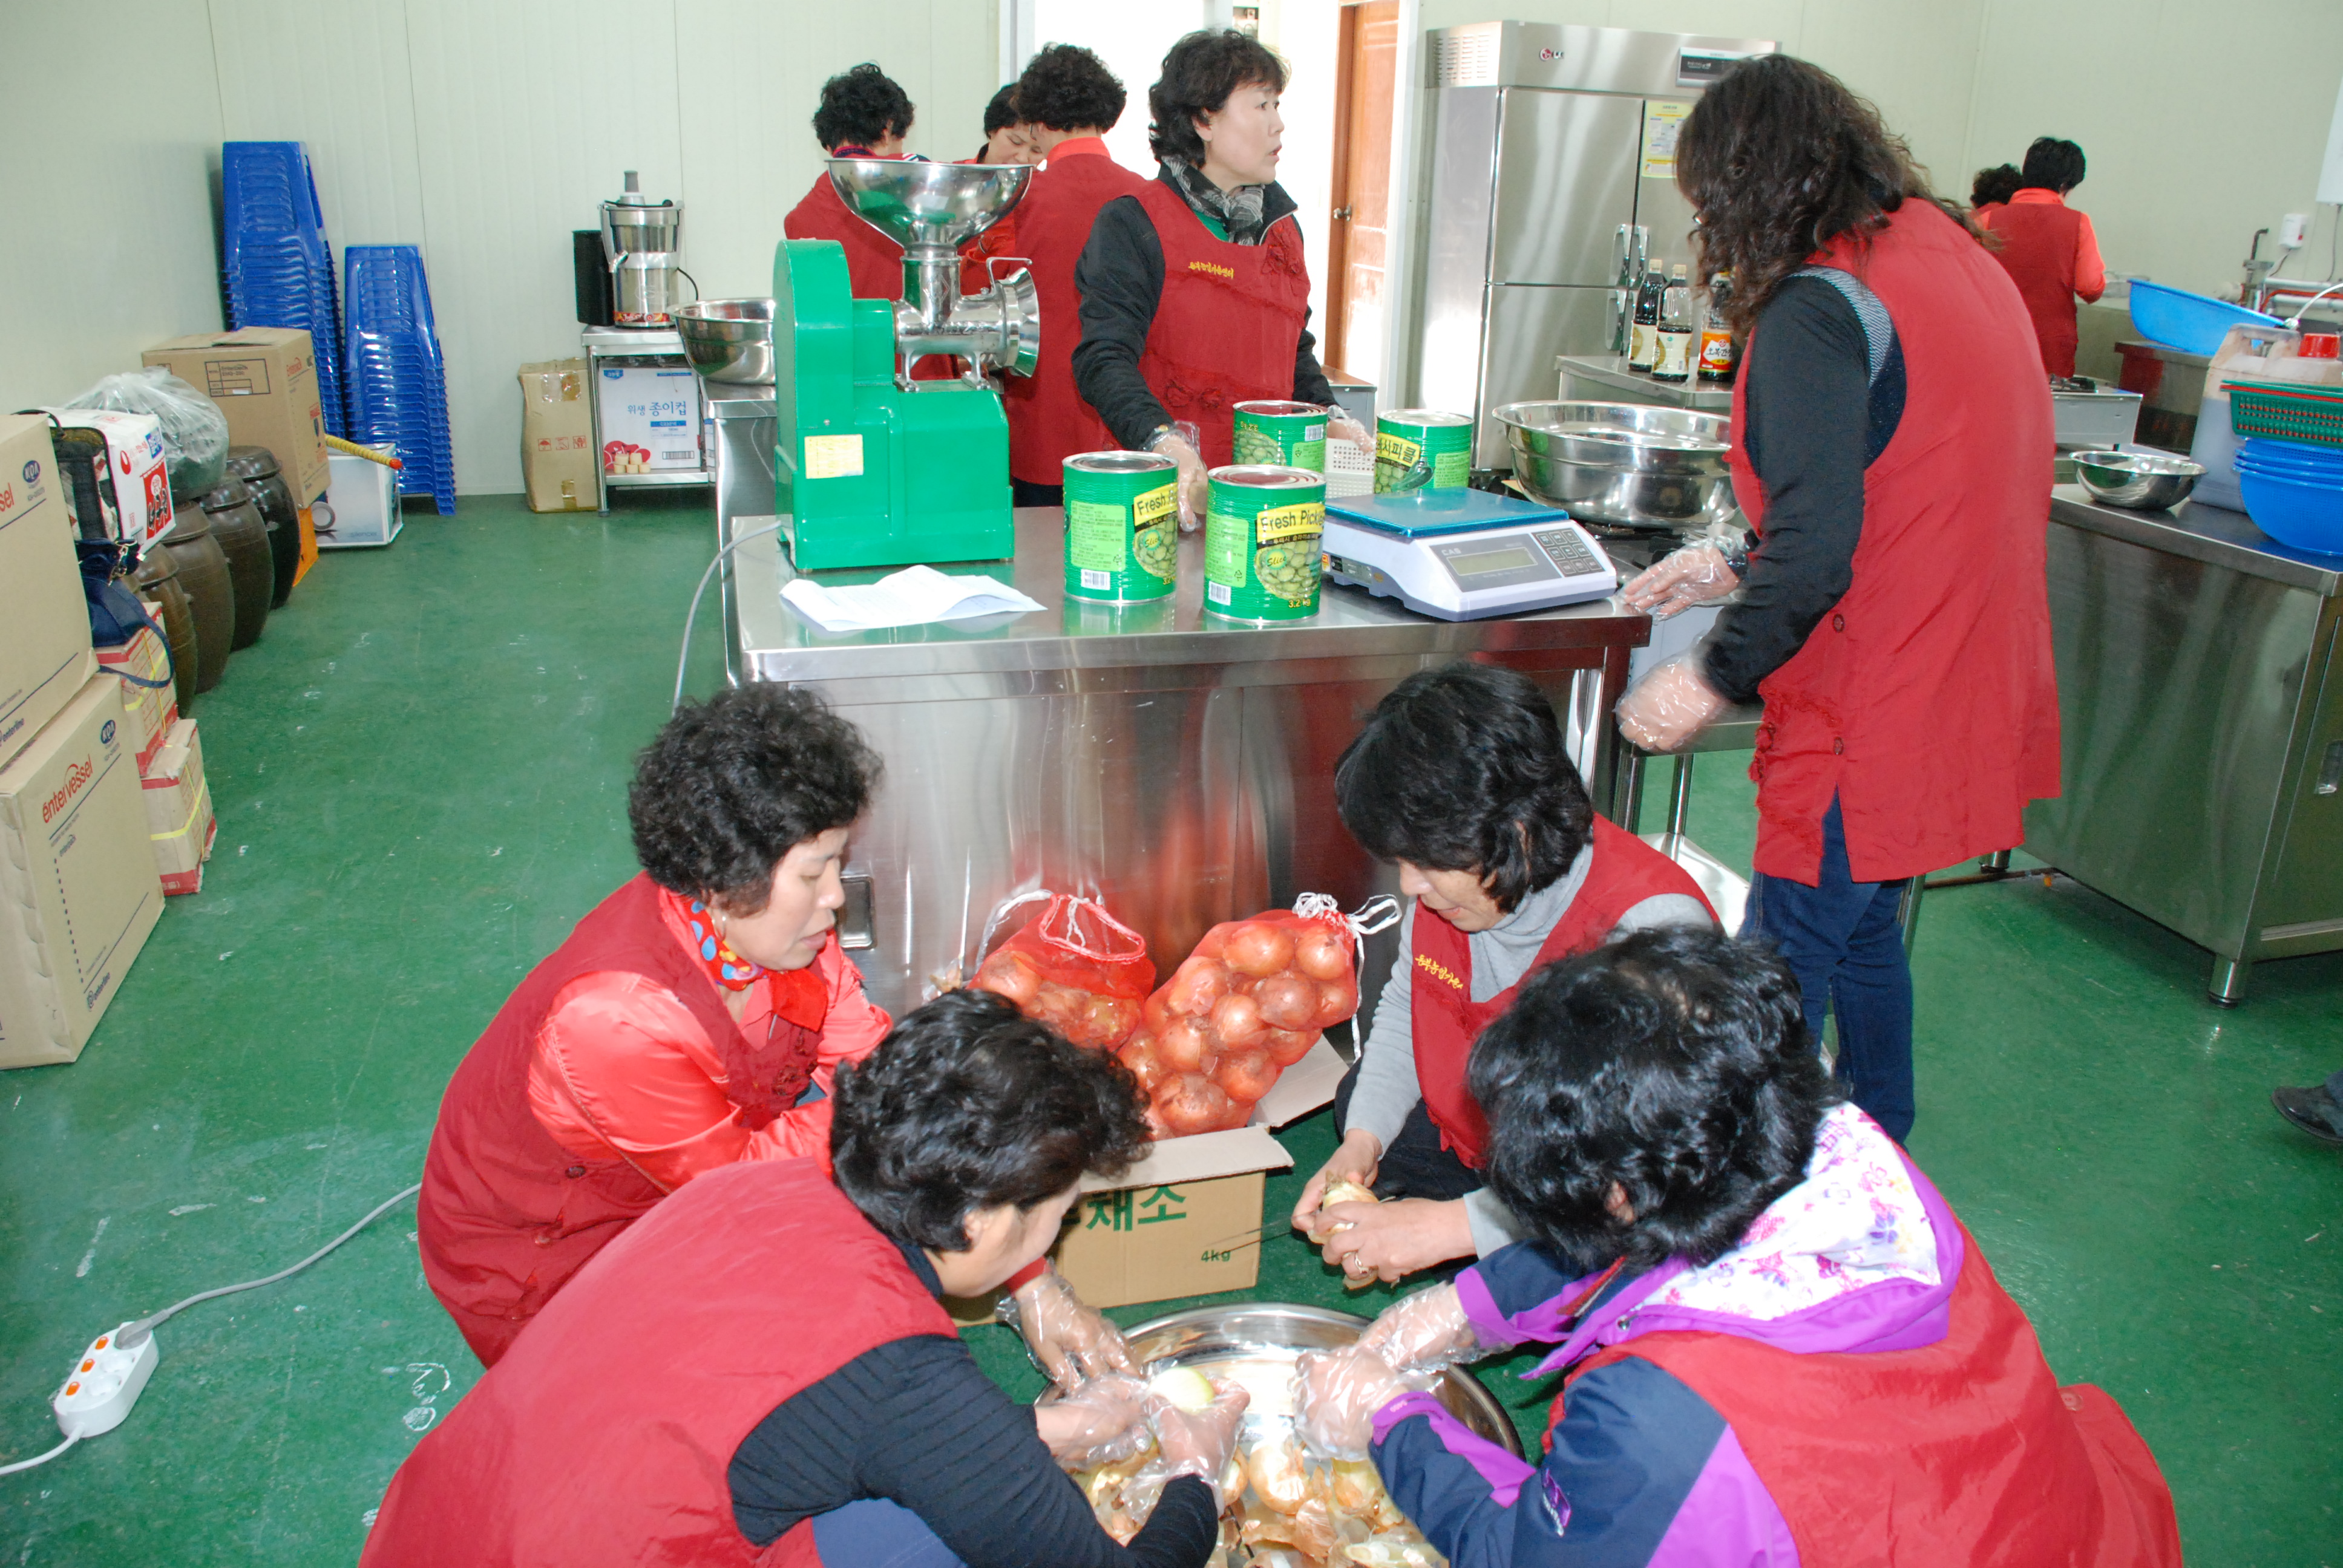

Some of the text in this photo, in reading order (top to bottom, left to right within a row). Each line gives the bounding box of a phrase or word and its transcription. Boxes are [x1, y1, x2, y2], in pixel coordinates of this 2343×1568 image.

[628, 401, 686, 417] 위생 종이컵
[1136, 493, 1166, 515] Fresh
[1261, 512, 1296, 531] Fresh
[1145, 535, 1160, 548] Slice
[1441, 547, 1461, 556] CAS
[1267, 555, 1286, 567] Slice
[1288, 599, 1300, 608] 3.2
[42, 754, 93, 823] entervessel
[1201, 1250, 1231, 1263] 4kg
